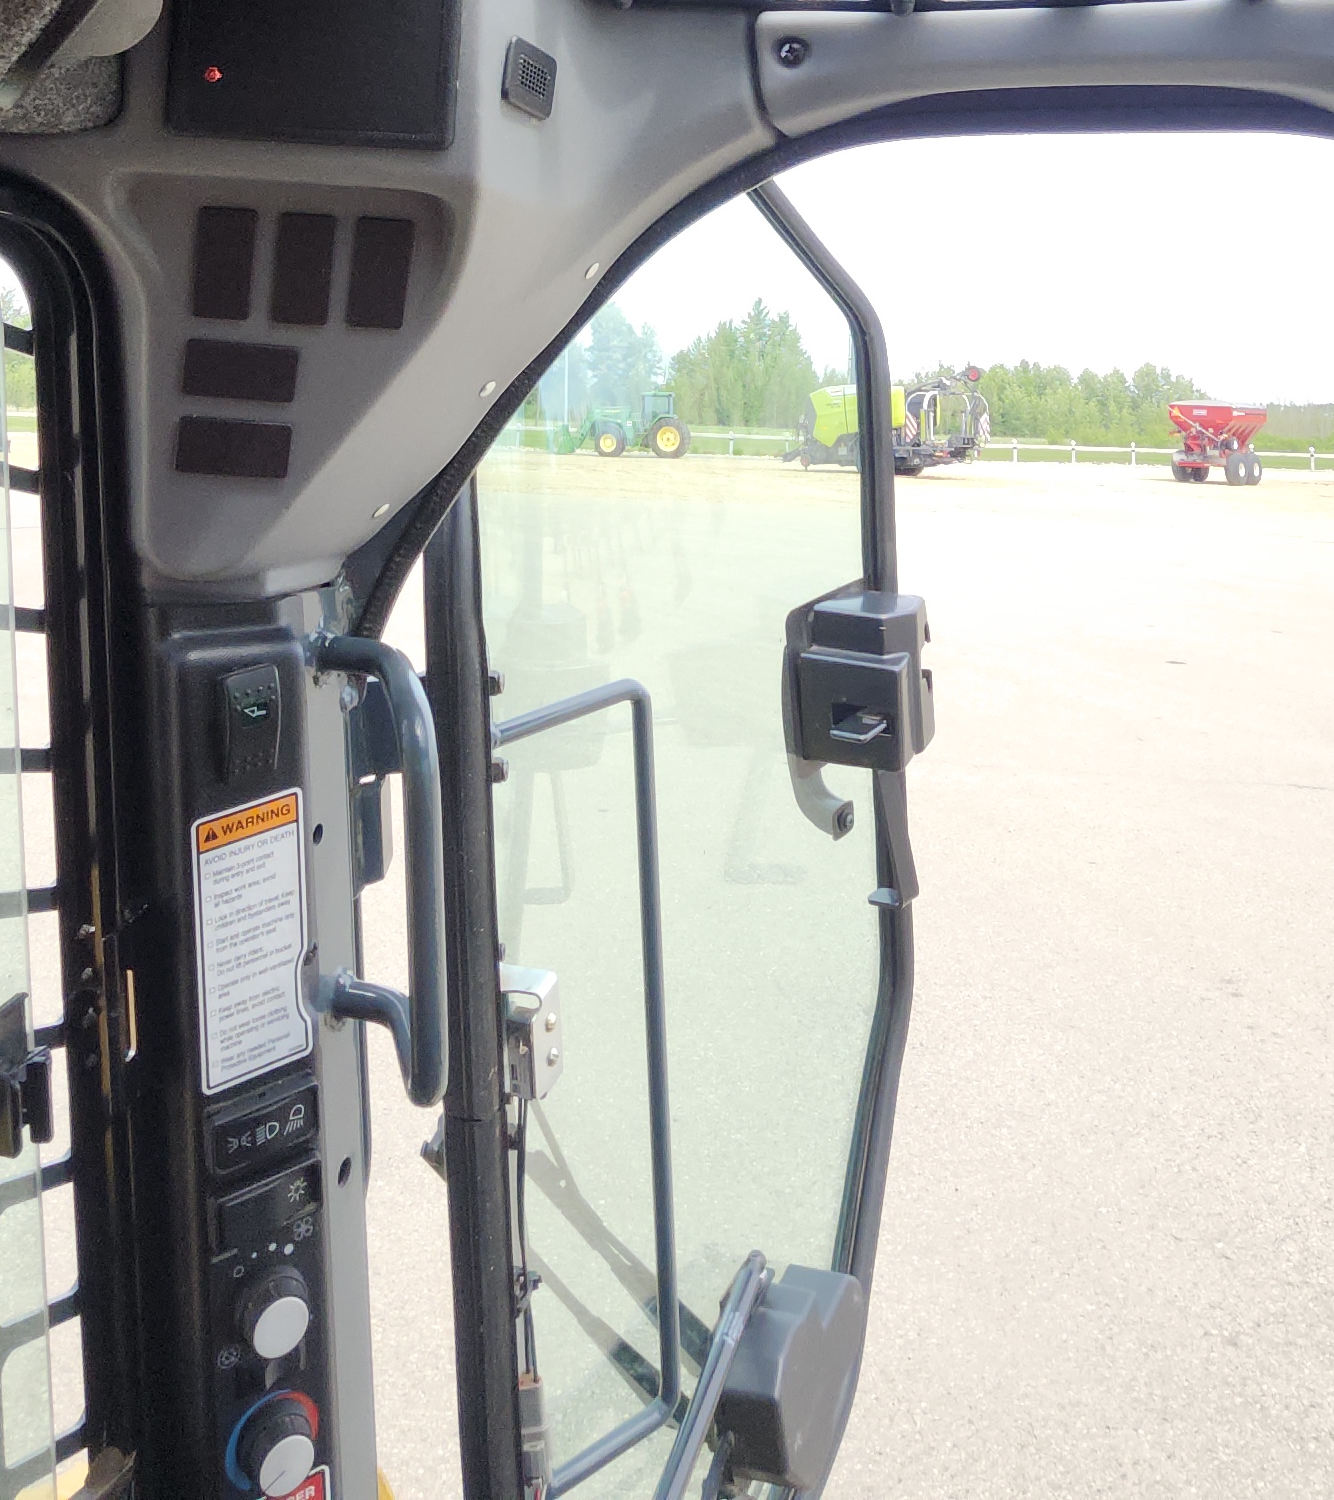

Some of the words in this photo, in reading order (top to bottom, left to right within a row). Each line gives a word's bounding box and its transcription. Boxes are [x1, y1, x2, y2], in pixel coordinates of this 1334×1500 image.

[220, 803, 291, 836] WARNING
[204, 853, 226, 865] AVOID
[229, 844, 255, 857] INJURY
[258, 839, 267, 847] OR
[270, 831, 294, 842] DEATH
